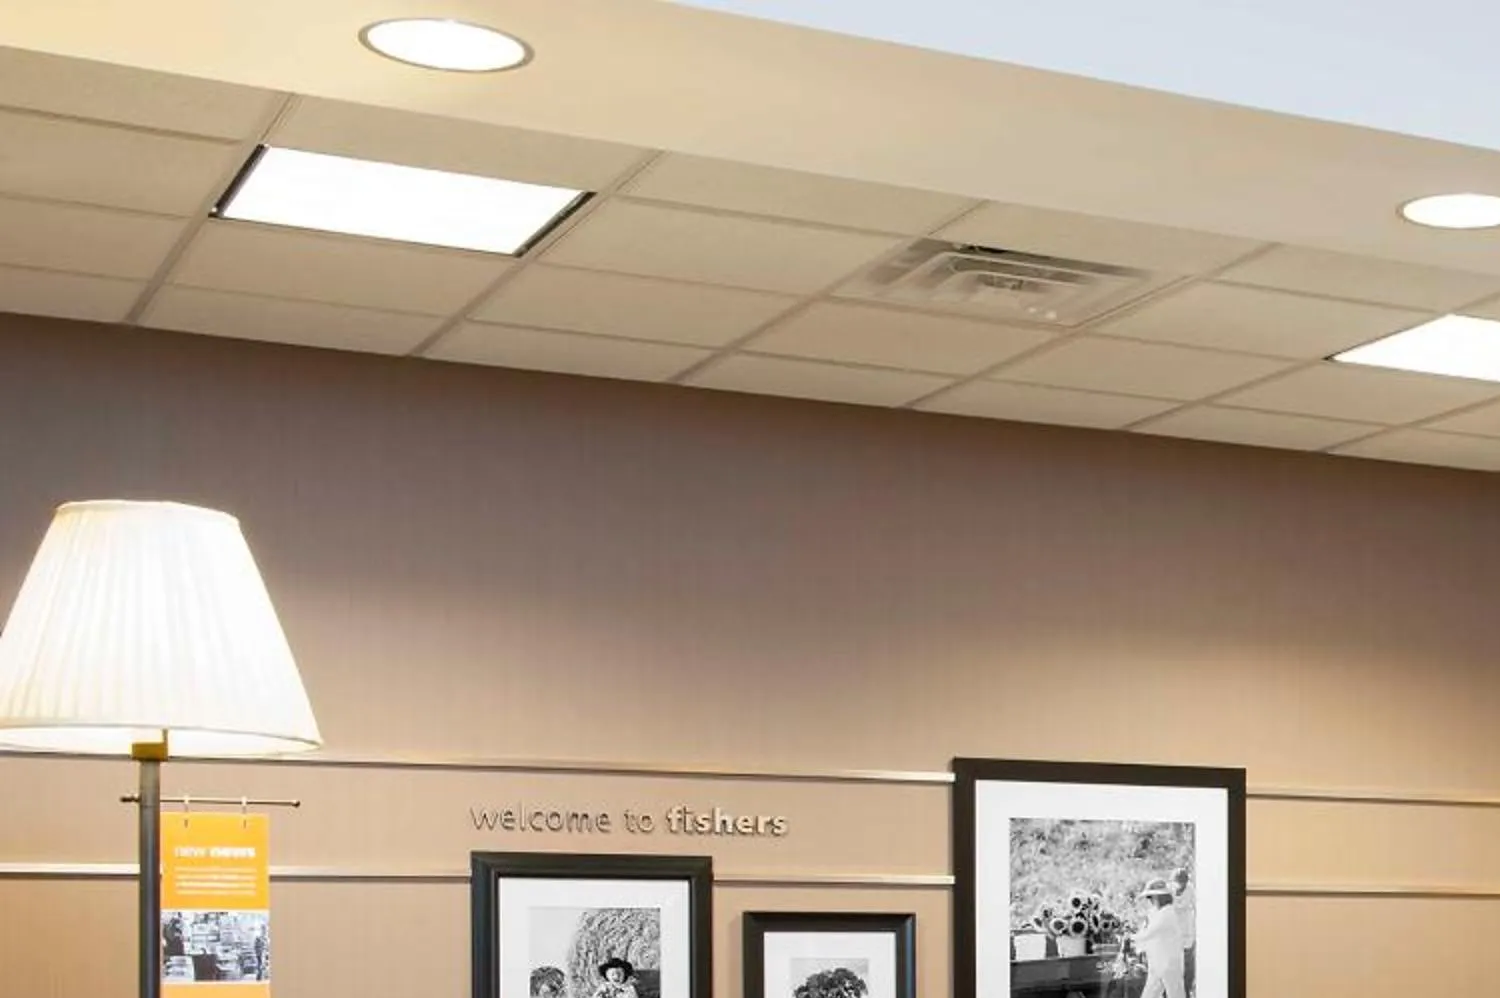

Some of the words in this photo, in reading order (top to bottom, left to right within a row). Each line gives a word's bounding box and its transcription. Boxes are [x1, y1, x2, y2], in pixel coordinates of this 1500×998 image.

[469, 804, 611, 833] welcome
[624, 809, 654, 833] to
[666, 804, 789, 836] fishers
